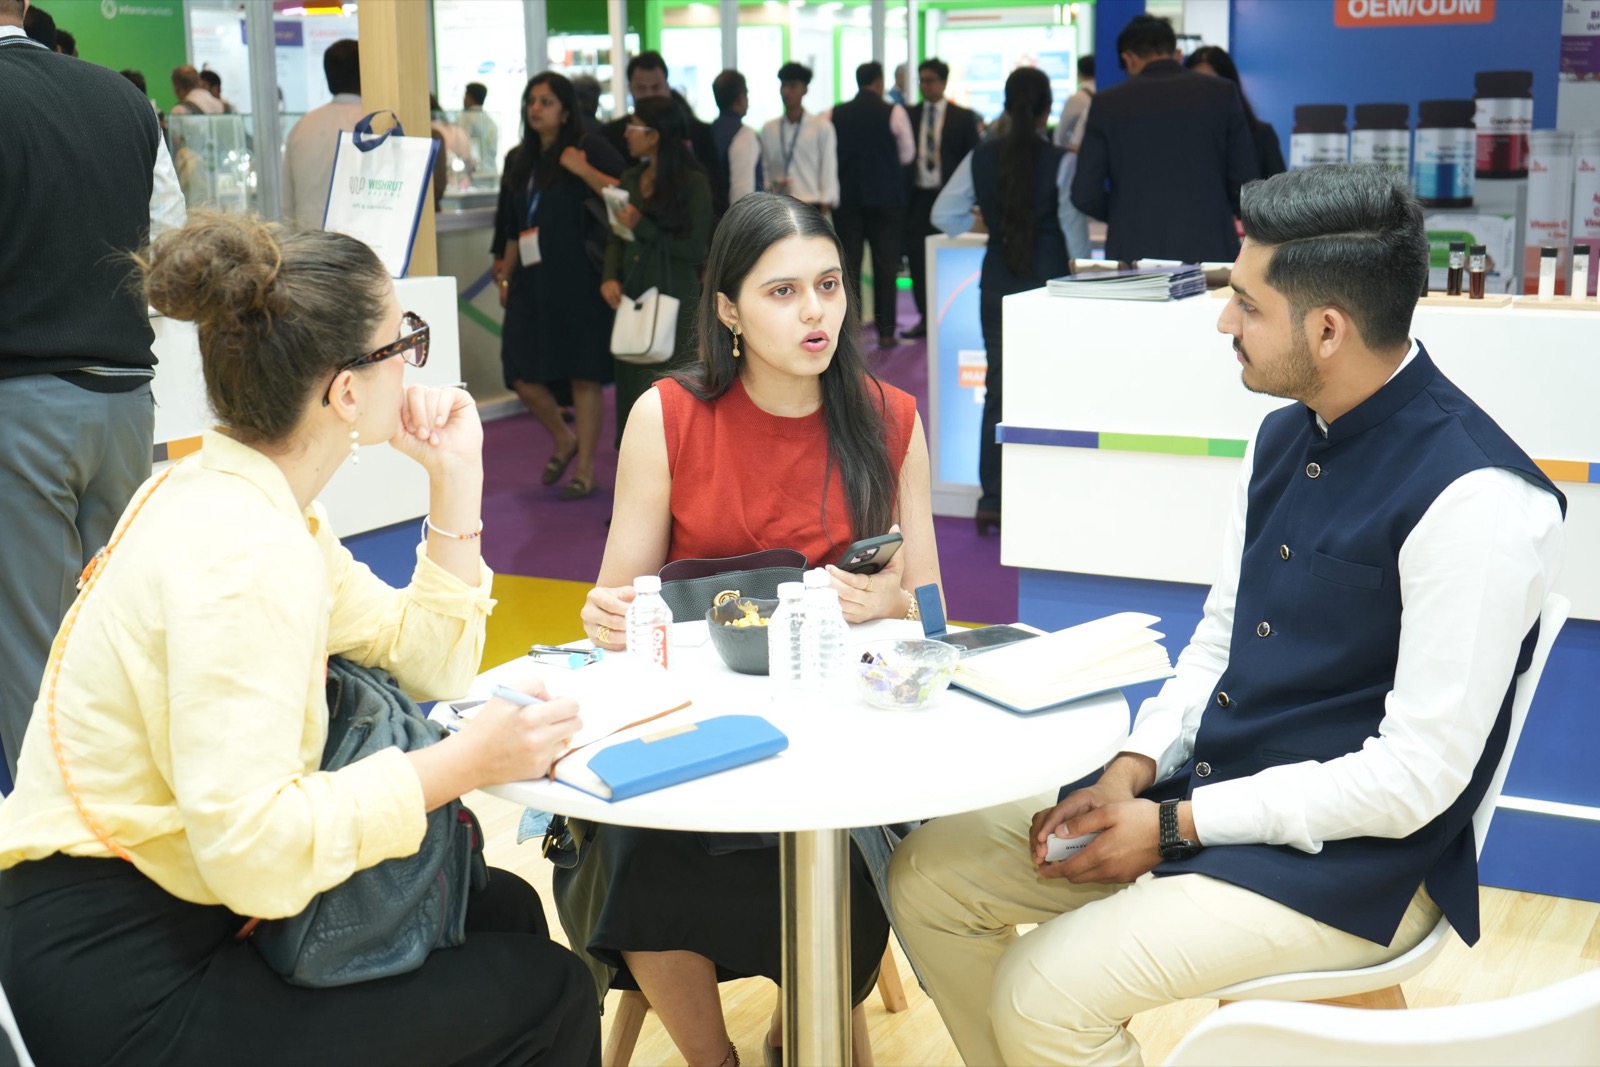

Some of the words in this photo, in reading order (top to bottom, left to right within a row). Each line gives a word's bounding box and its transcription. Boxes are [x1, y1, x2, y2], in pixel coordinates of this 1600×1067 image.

[1347, 0, 1481, 18] OEM/ODM
[368, 177, 404, 191] WISHRUT
[1530, 220, 1559, 229] Vitamin
[1561, 220, 1568, 229] C
